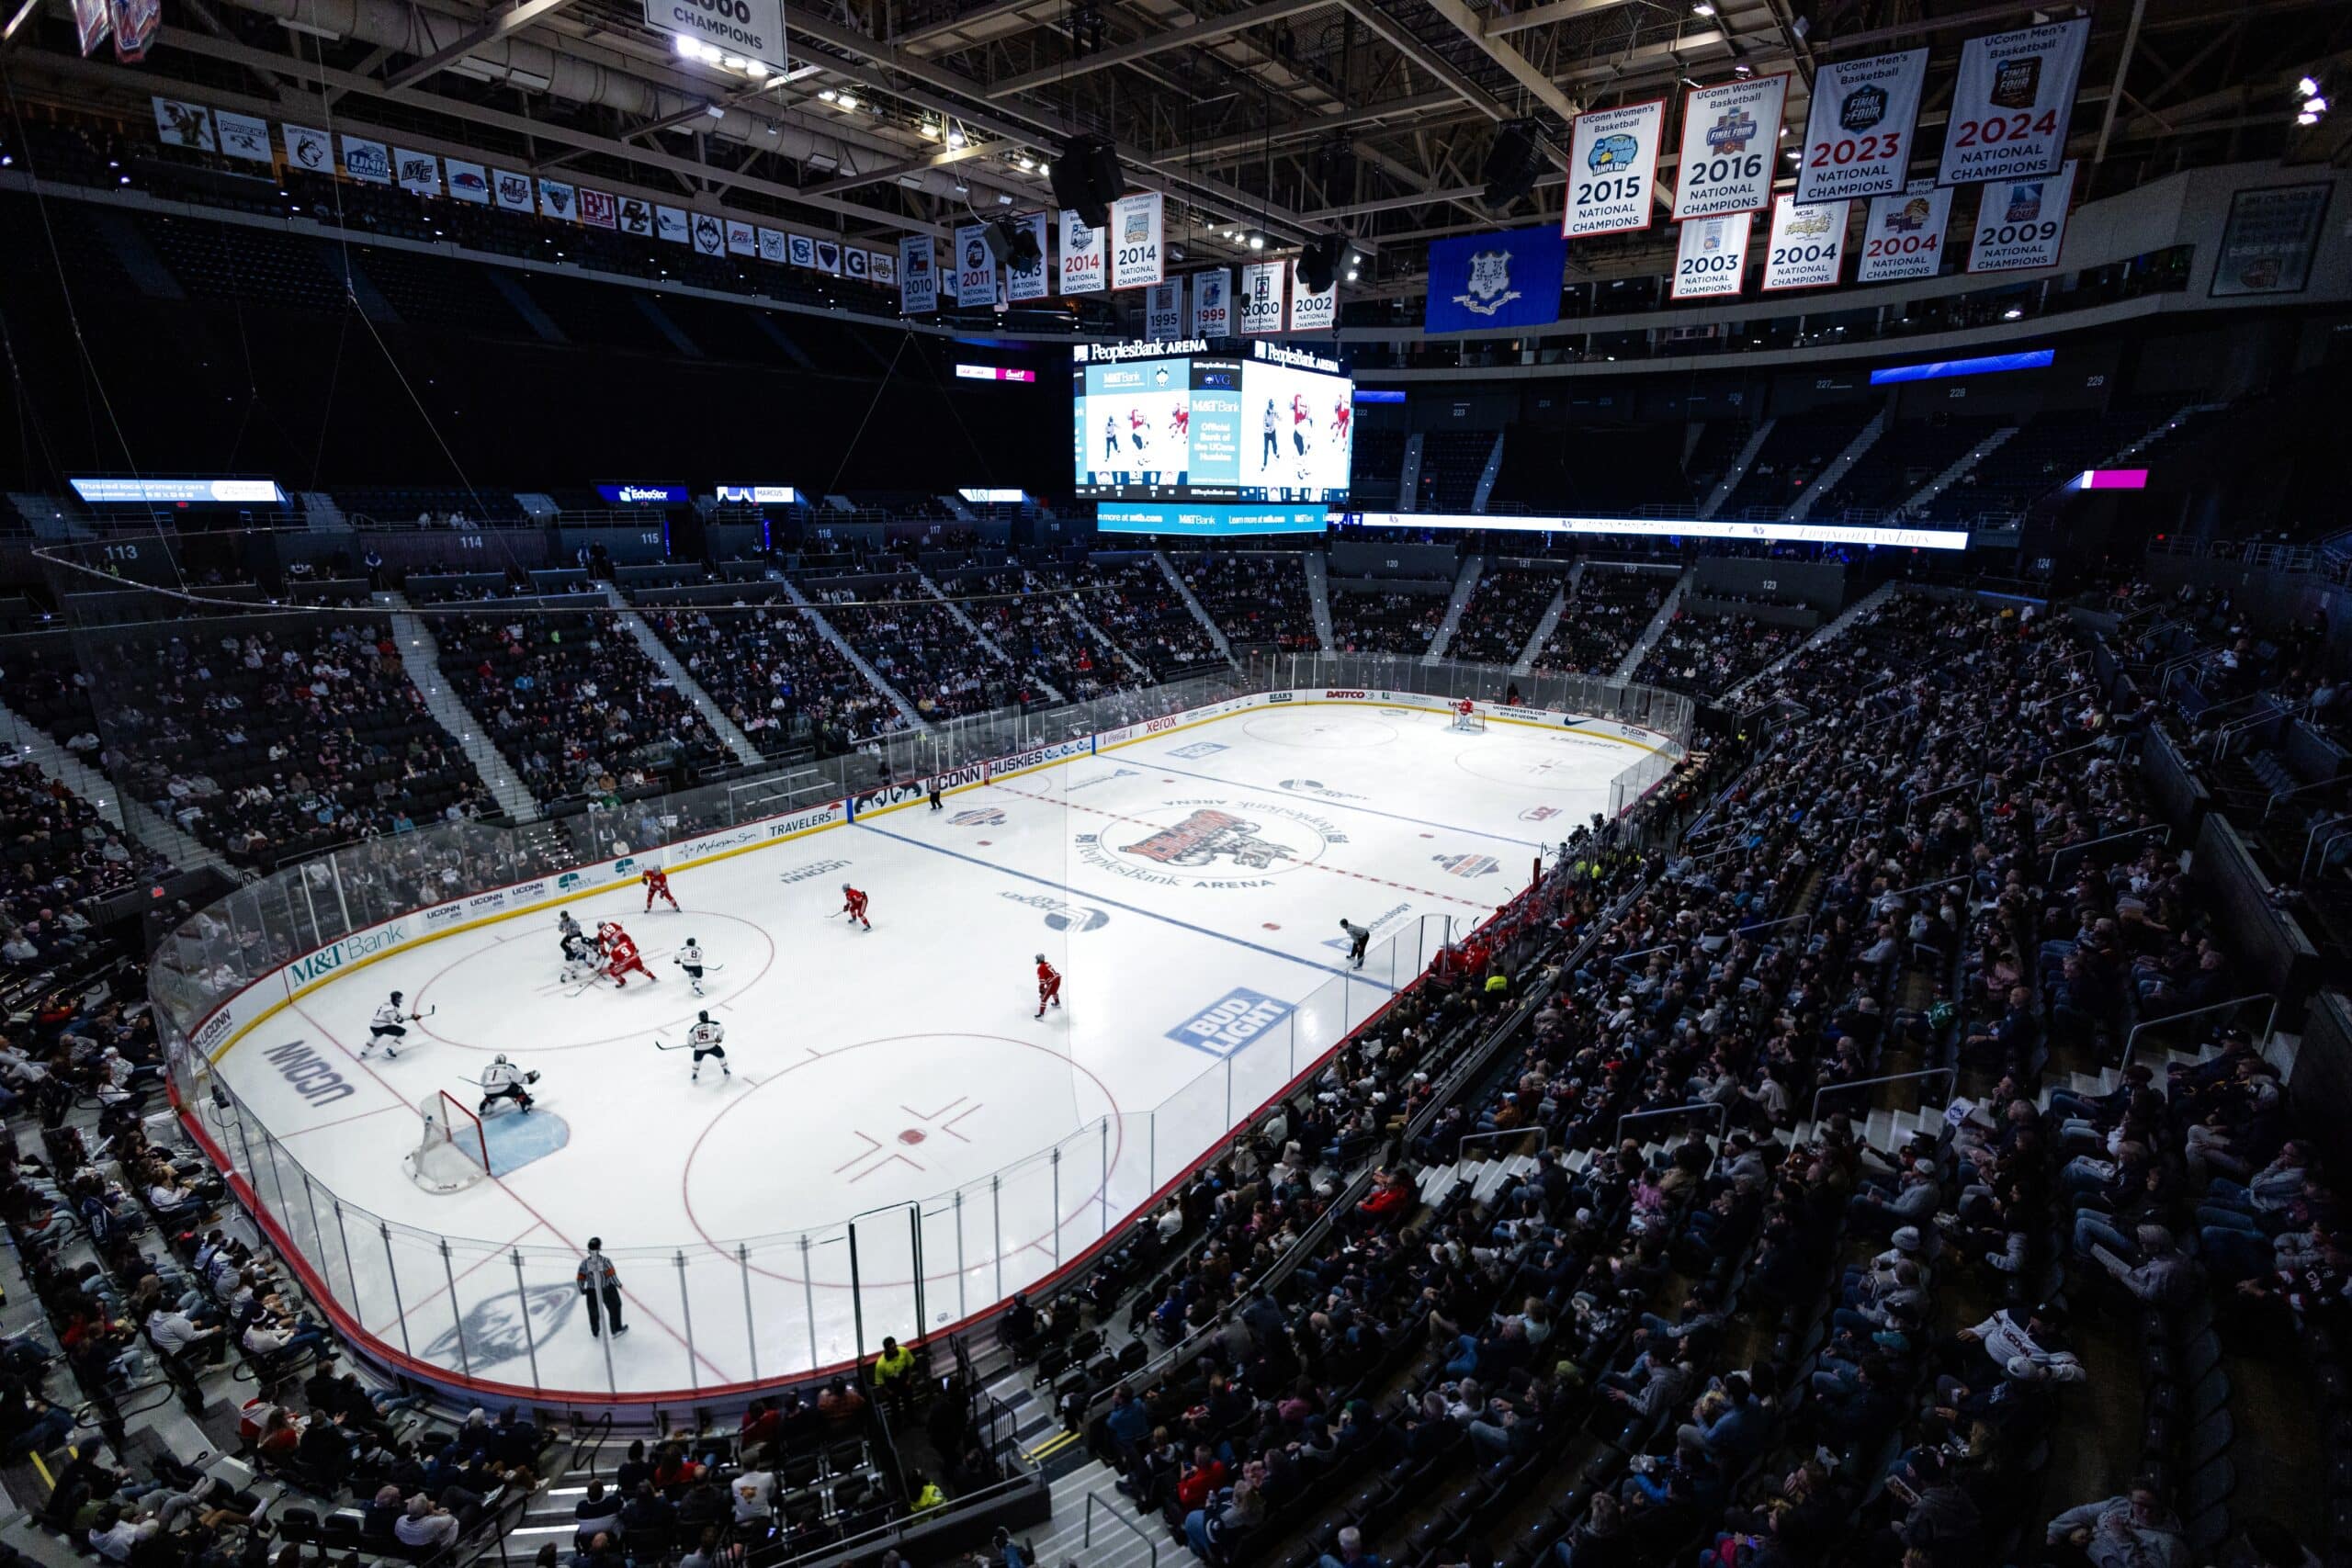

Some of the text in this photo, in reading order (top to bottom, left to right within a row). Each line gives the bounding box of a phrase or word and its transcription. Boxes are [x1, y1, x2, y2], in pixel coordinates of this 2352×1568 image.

[684, 0, 751, 24] 000
[673, 7, 763, 49] CHAMPIONS
[1984, 24, 2067, 46] UConn Men's
[1989, 39, 2056, 59] Basketball
[1835, 53, 1908, 73] UConn Men's
[1839, 67, 1899, 85] Basketball
[1697, 78, 1779, 99] UConn Women's
[1709, 93, 1761, 109] Basketball
[1582, 105, 1655, 124] UConn Women's
[1594, 118, 1640, 133] Basketball
[1955, 109, 2056, 148] 2024
[1811, 131, 1901, 168] 2023
[1961, 144, 2043, 164] NATIONAL
[350, 153, 388, 172] UNH
[1593, 164, 1613, 175] TAMPA
[1689, 154, 1762, 186] 2016
[1951, 160, 2048, 180] CHAMPIONS
[1815, 165, 1889, 183] NATIONAL
[1577, 176, 1640, 205] 2015
[1690, 185, 1755, 200] NATIONAL
[1807, 179, 1894, 198] CHAMPIONS
[582, 190, 614, 220] BU
[1124, 202, 1150, 211] Basketball
[1578, 203, 1635, 219] NATIONAL
[1682, 197, 1758, 215] CHAMPIONS
[1572, 216, 1639, 232] CHAMPIONS
[1979, 221, 2056, 245] 2009
[1867, 233, 1938, 257] 2004
[1984, 245, 2044, 257] NATIONAL
[1118, 245, 1157, 265] 2014
[1772, 243, 1837, 265] 2004
[847, 251, 865, 275] G
[1065, 254, 1100, 273] 2014
[1680, 254, 1738, 275] 2003
[1872, 257, 1927, 268] NATIONAL
[1977, 256, 2048, 269] CHAMPIONS
[1067, 273, 1098, 283] NATIONAL
[1120, 265, 1154, 276] NATIONAL
[1777, 265, 1827, 276] NATIONAL
[1866, 266, 1930, 279] CHAMPIONS
[905, 278, 933, 294] 2010
[963, 271, 989, 287] 2011
[1012, 281, 1040, 289] NATIONAL
[1117, 275, 1158, 287] CHAMPIONS
[1685, 275, 1729, 285] NATIONAL
[1771, 275, 1830, 287] CHAMPIONS
[1011, 289, 1044, 299] CHAMPIONS
[1064, 282, 1101, 292] CHAMPIONS
[1679, 284, 1733, 294] CHAMPIONS
[961, 296, 992, 305] CHAMPIONS
[1295, 297, 1332, 312] 2002
[1150, 313, 1177, 327] 1995
[1196, 308, 1226, 321] 1999
[1244, 324, 1277, 333] CHAMPIONS
[1295, 319, 1330, 328] CHAMPIONS
[1091, 338, 1207, 364] PeoplesBank ARENA
[1268, 343, 1340, 373] PeoplesBank ARENA
[1815, 379, 1831, 389] 227
[2086, 376, 2104, 388] 229
[1949, 388, 1967, 398] 228
[1218, 400, 1239, 412] Bank
[631, 489, 668, 499] EchoStar
[1196, 514, 1216, 525] Bank
[818, 529, 831, 538] 116
[930, 525, 941, 535] 117
[460, 536, 482, 548] 114
[641, 533, 659, 544] 115
[105, 545, 138, 559] 113
[1385, 559, 1398, 568] 120
[2037, 558, 2051, 570] 124
[1762, 580, 1778, 590] 123
[1326, 691, 1364, 699] DATTCO
[1146, 716, 1177, 734] xerox
[1628, 728, 1647, 738] UCONN
[989, 750, 1043, 775] HUSKIES
[926, 766, 980, 794] UCONN
[770, 811, 831, 838] TRAVELERS
[737, 832, 757, 843] Sun
[1080, 843, 1277, 889] PeoplesBank ARENA
[513, 882, 544, 896] UCONN
[470, 892, 503, 907] UCONN
[426, 903, 460, 919] UCONN
[602, 924, 616, 938] 49
[289, 922, 406, 987] M&T Bank
[620, 946, 631, 957] 9
[1186, 998, 1252, 1038] BUD
[200, 1009, 232, 1044] UCONN
[1199, 1000, 1293, 1055] LIGHT
[263, 1040, 356, 1108] UCONN
